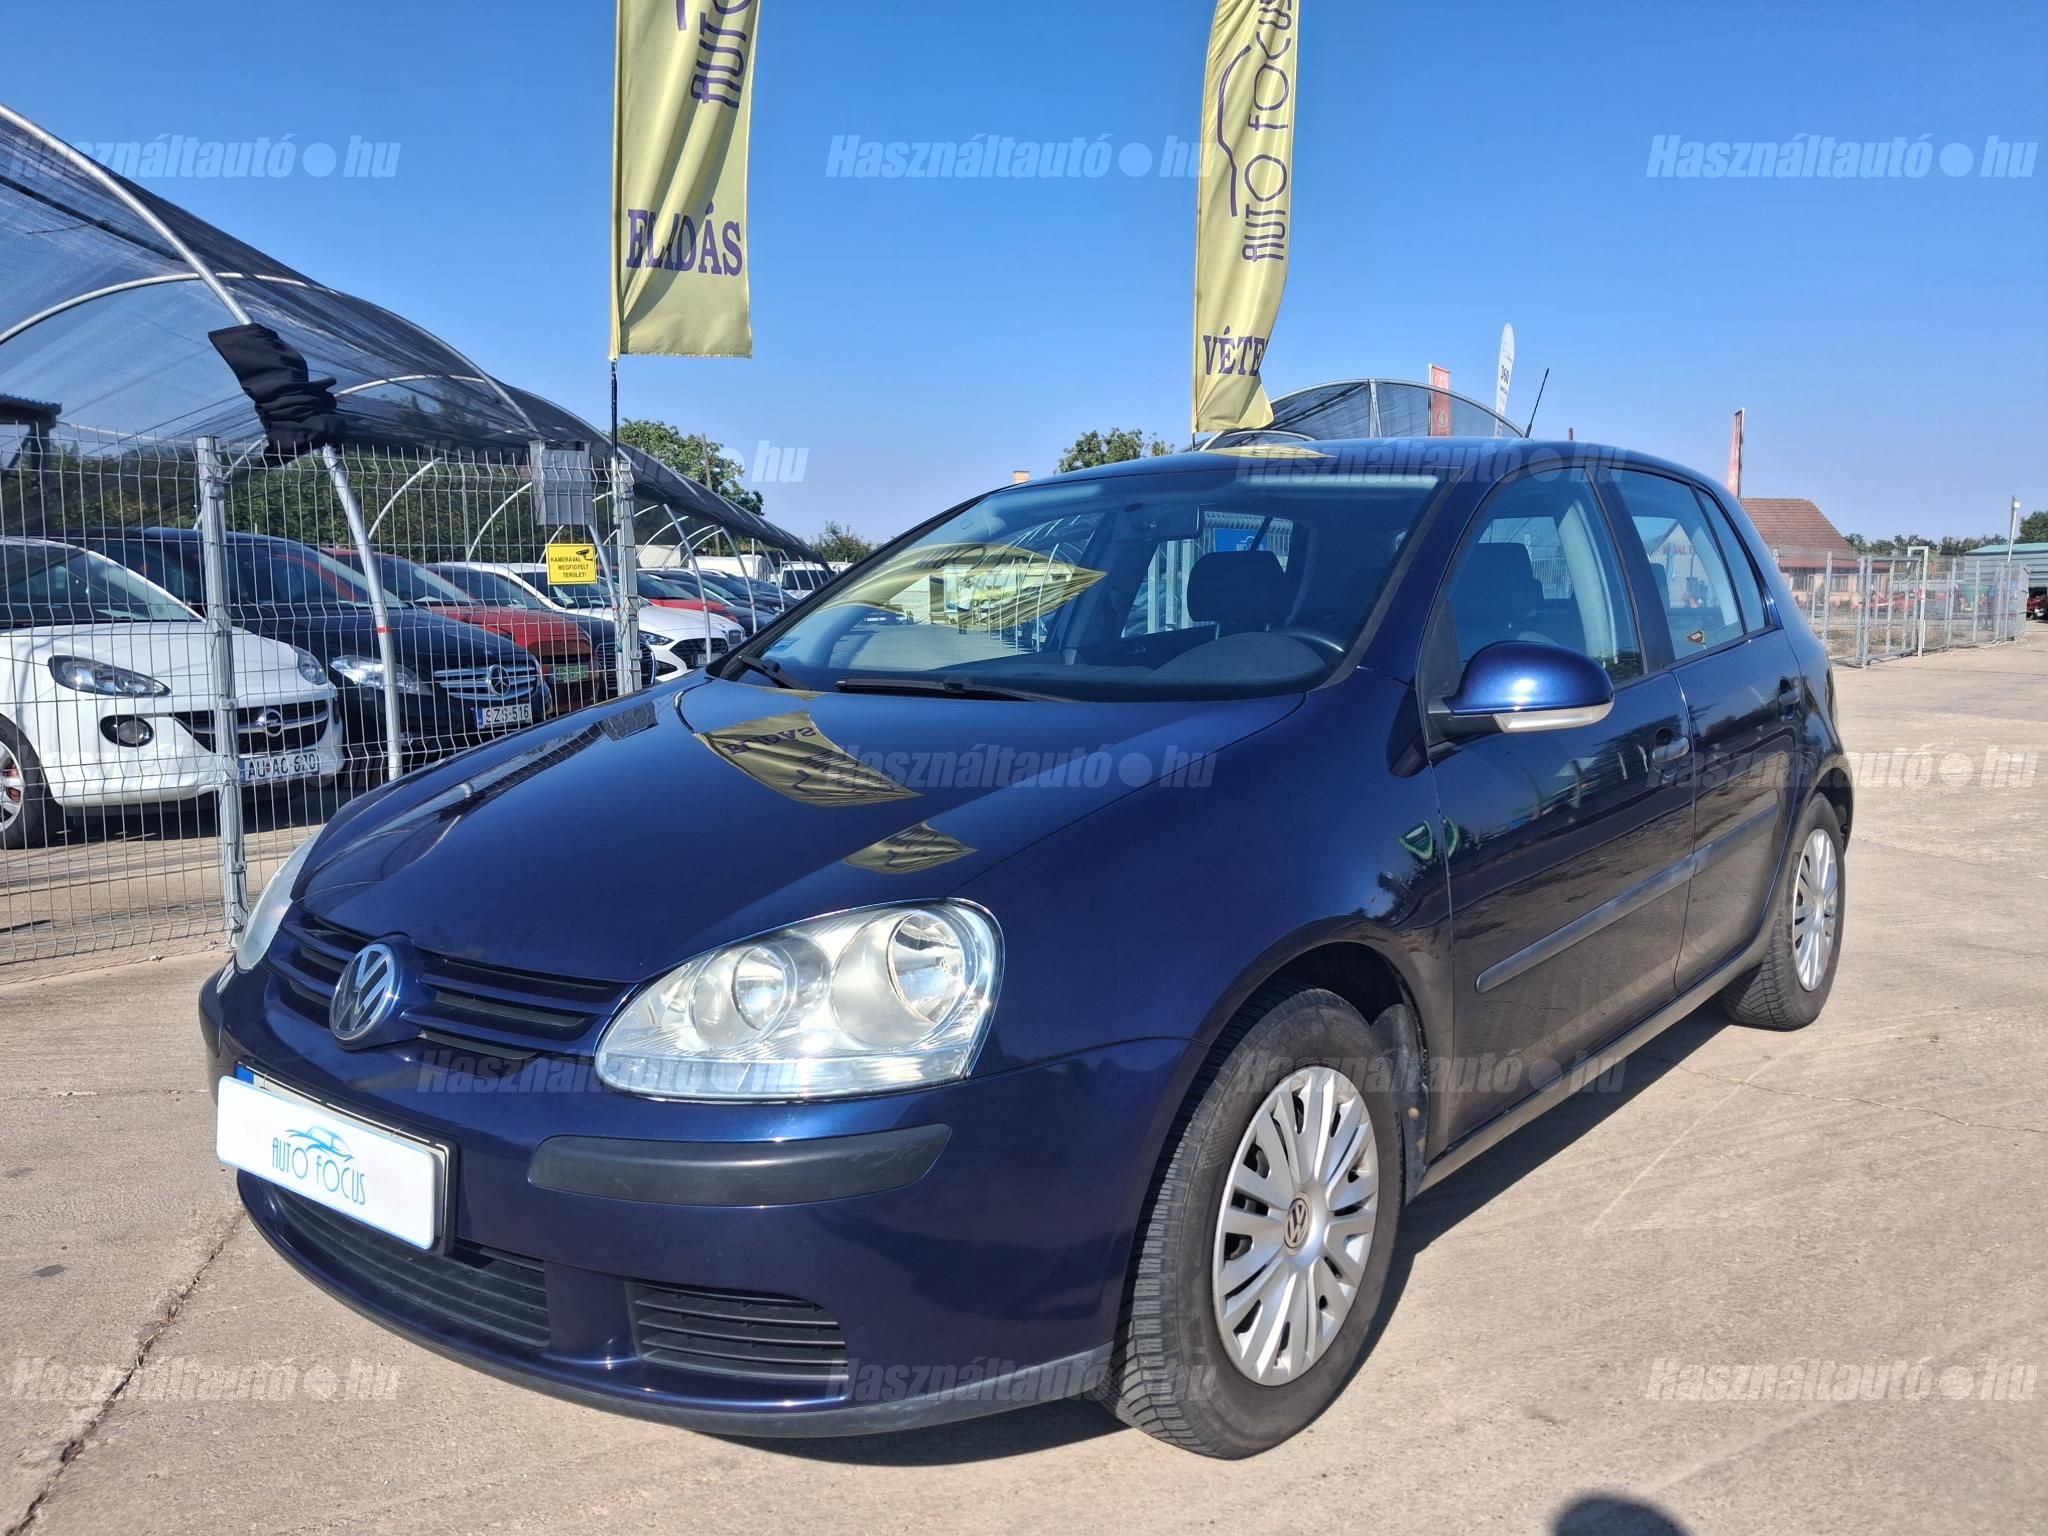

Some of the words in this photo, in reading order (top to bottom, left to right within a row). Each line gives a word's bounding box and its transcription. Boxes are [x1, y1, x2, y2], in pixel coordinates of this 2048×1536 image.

[1242, 153, 1288, 261] AUTO
[1202, 325, 1269, 377] VÉTE
[272, 1136, 309, 1180] AUTO
[316, 1155, 366, 1206] FOCUS
